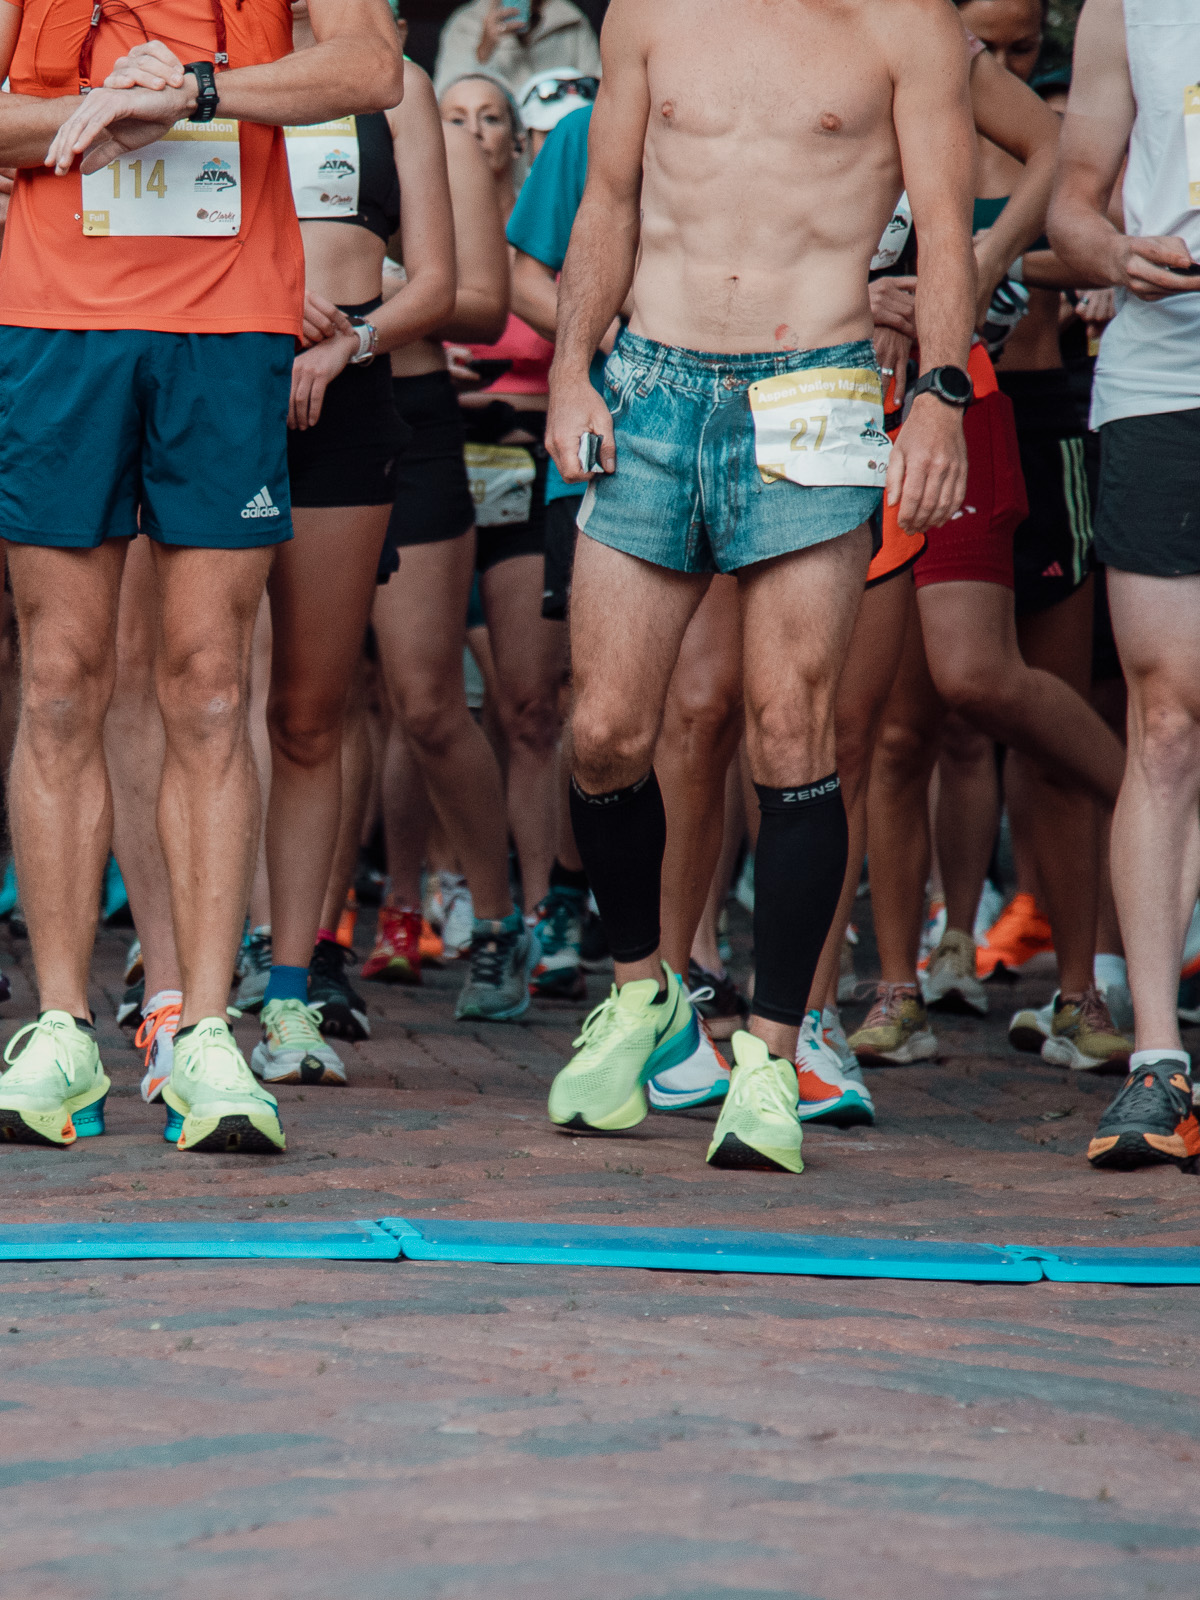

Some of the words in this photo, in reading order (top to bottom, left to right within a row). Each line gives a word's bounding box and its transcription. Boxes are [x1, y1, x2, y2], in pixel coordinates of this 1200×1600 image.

[173, 119, 233, 133] Marathon
[108, 159, 168, 199] 114
[758, 386, 798, 404] Aspen
[799, 380, 836, 393] Valley
[789, 415, 829, 452] 27
[241, 506, 280, 519] adidas
